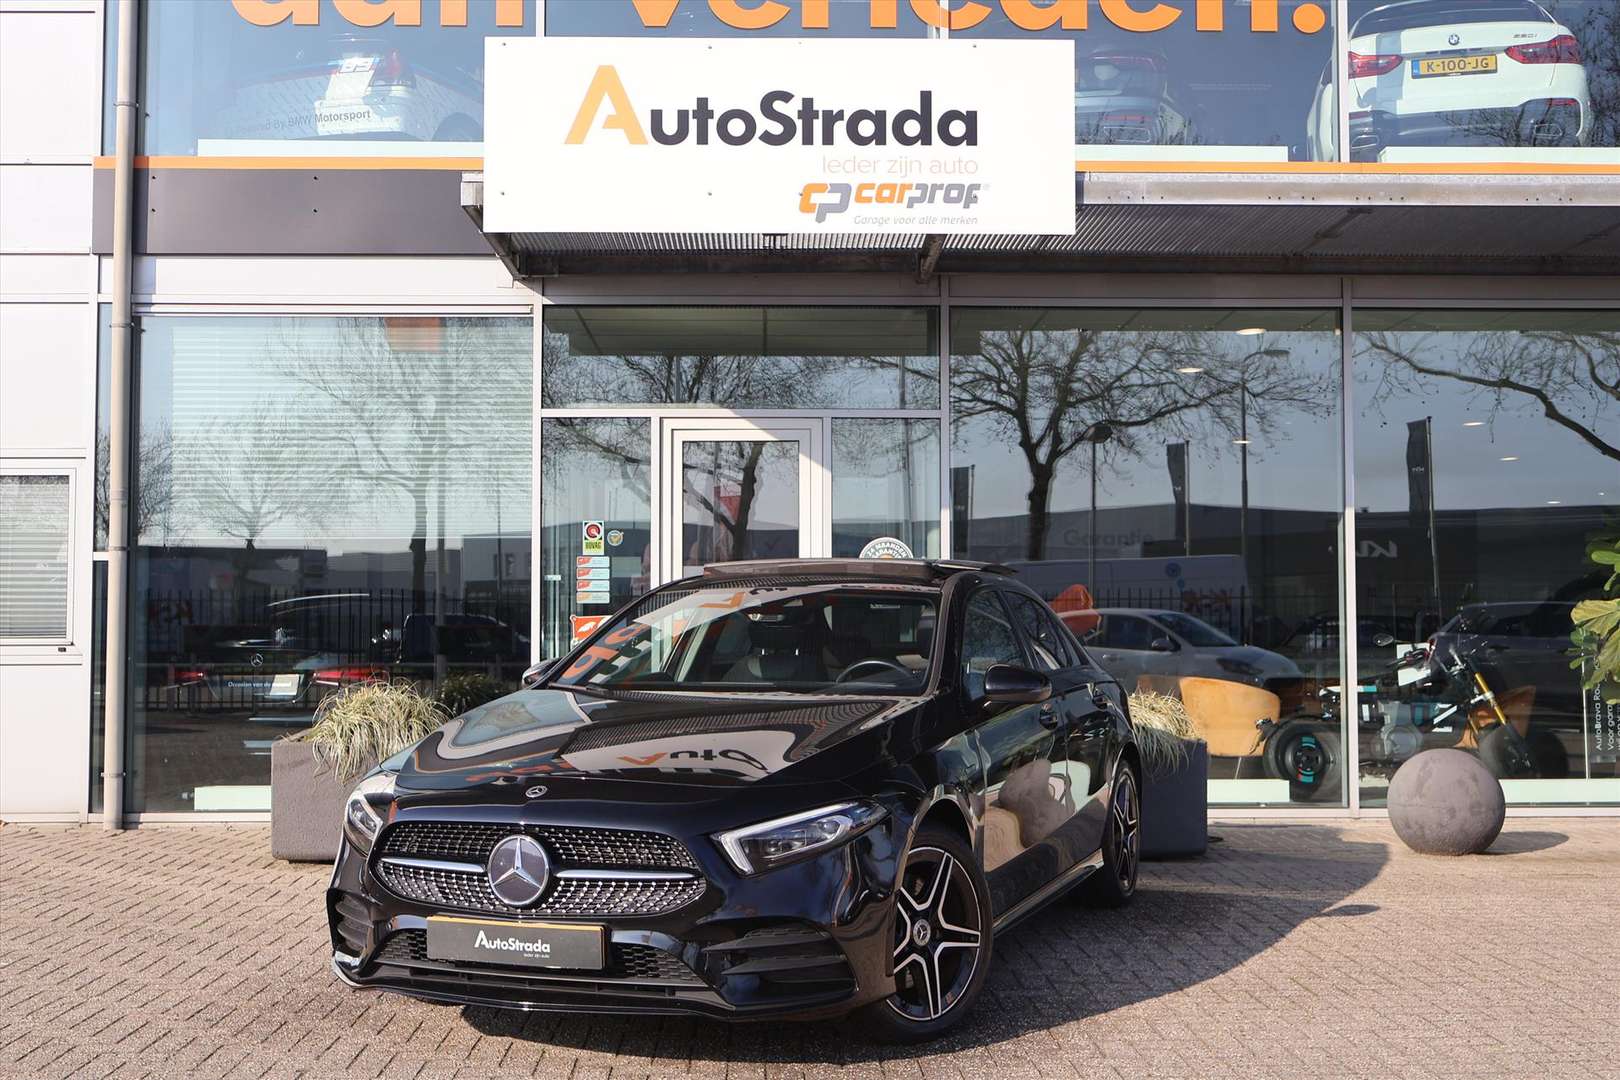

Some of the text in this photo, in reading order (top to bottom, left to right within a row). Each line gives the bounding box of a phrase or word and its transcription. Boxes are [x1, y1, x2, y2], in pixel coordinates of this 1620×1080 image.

[1426, 57, 1489, 73] K-100-JG
[564, 65, 978, 146] AutoStrada
[314, 110, 371, 124] Motorsport
[822, 155, 979, 177] Ieder zijn auto
[854, 215, 978, 227] Garage voor alle merken
[473, 929, 551, 953] AutoStrada
